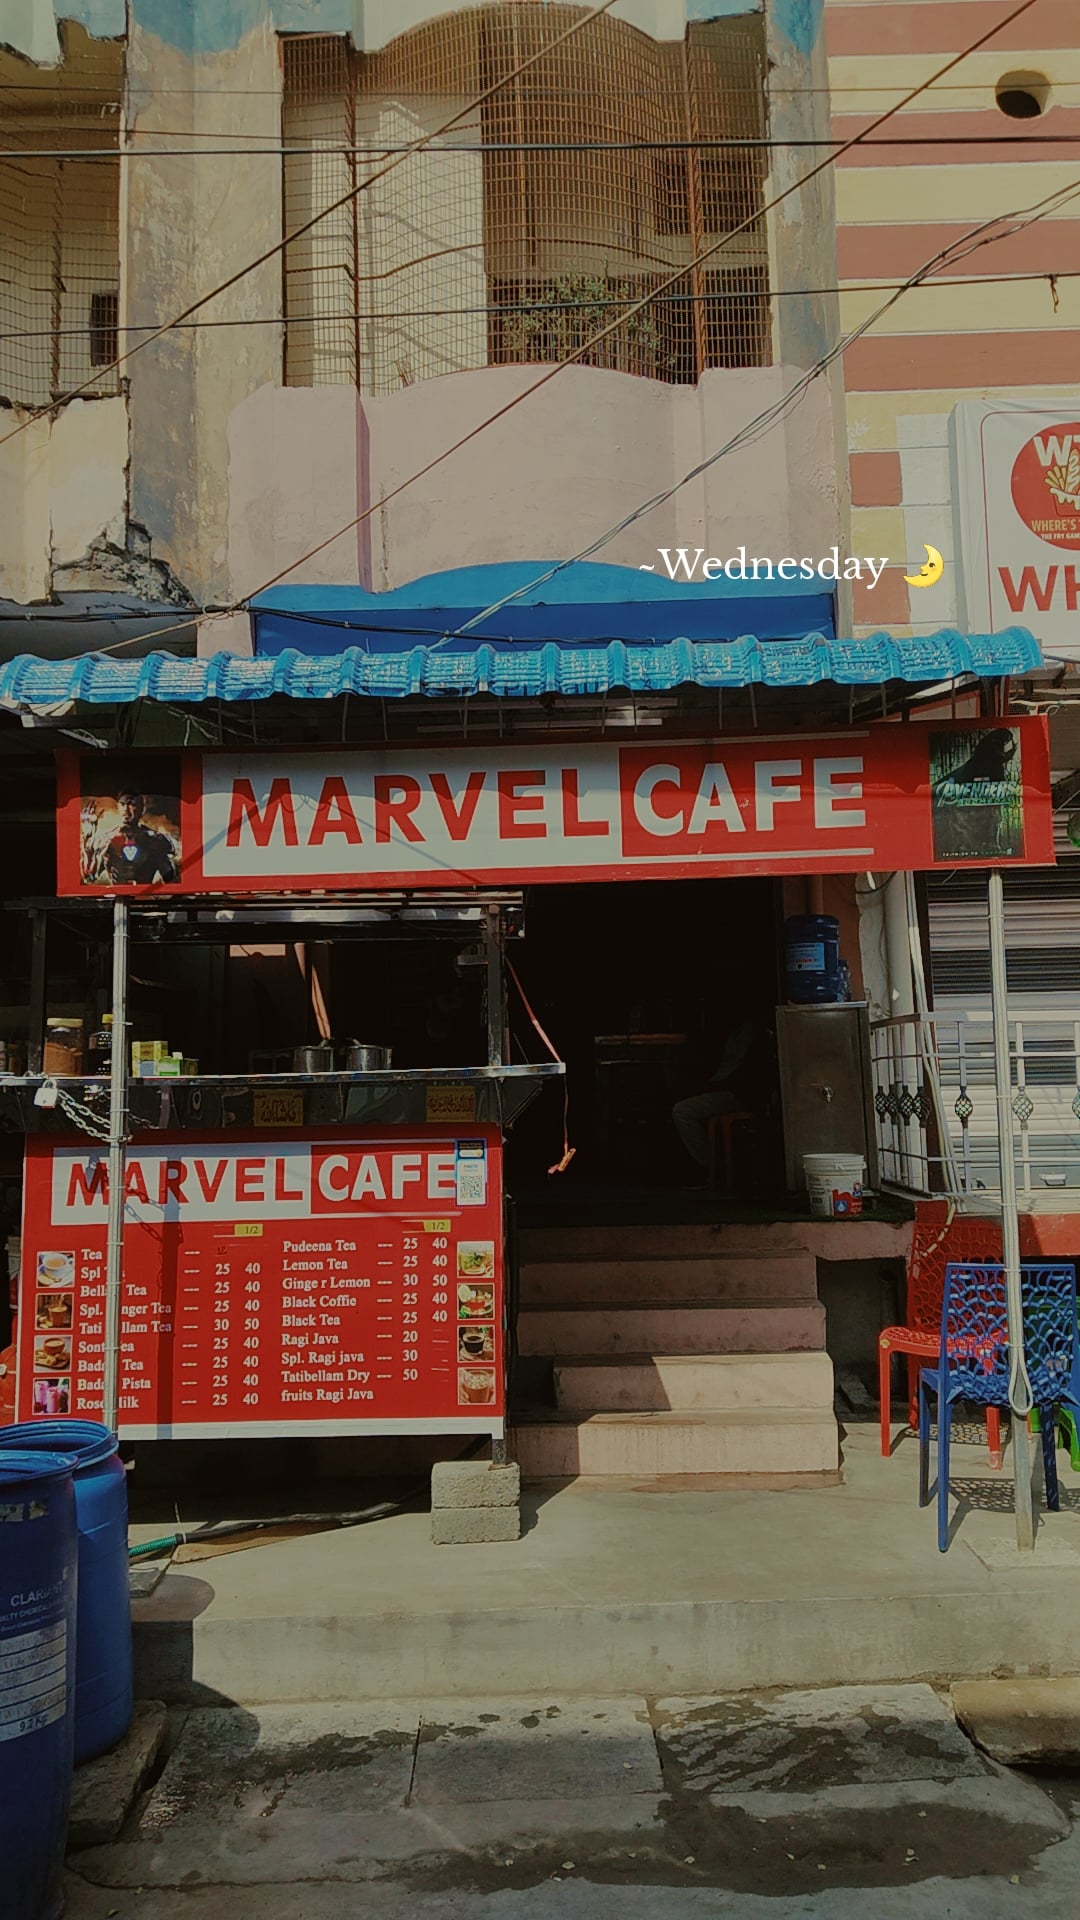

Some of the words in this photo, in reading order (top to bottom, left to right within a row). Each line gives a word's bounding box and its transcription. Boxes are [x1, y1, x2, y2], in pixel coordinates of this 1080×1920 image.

[1031, 519, 1077, 531] WHERE'S
[225, 767, 611, 848] MARVEL
[633, 756, 866, 837] CAFE
[66, 1158, 304, 1207] MARVEL
[318, 1153, 456, 1202] CAFE
[245, 1225, 259, 1235] 1/2
[432, 1221, 446, 1231] 1/2
[283, 1240, 333, 1253] Pudeena
[335, 1239, 357, 1251] Tea
[403, 1237, 418, 1250] 25
[432, 1237, 448, 1249] 40
[81, 1248, 103, 1260] Tea
[282, 1259, 324, 1271] Lemon
[327, 1258, 348, 1270] Tea
[403, 1255, 418, 1268] 25
[432, 1254, 448, 1267] 40
[80, 1266, 101, 1281] Spl
[215, 1263, 230, 1276] 25
[245, 1262, 261, 1275] 40
[126, 1283, 147, 1296] Tea
[214, 1281, 230, 1294] 25
[244, 1280, 260, 1293] 40
[330, 1276, 371, 1288] Lemon
[403, 1273, 419, 1286] 30
[432, 1274, 448, 1287] 50
[80, 1303, 103, 1318] Spl.
[150, 1302, 172, 1314] Tea
[214, 1299, 230, 1312] 25
[244, 1299, 260, 1311] 40
[282, 1295, 317, 1308] Black
[402, 1292, 418, 1305] 25
[432, 1292, 448, 1305] 40
[150, 1320, 172, 1333] Tea
[213, 1318, 230, 1331] 30
[244, 1317, 260, 1331] 50
[282, 1314, 317, 1327] Black
[319, 1313, 341, 1326] Tea
[402, 1311, 418, 1324] 25
[431, 1309, 448, 1323] 40
[78, 1341, 106, 1354] Sont
[120, 1341, 135, 1352] ea
[213, 1337, 229, 1350] 25
[243, 1336, 260, 1349] 40
[281, 1332, 310, 1348] Ragi
[312, 1332, 340, 1345] Java
[402, 1330, 418, 1343] 20
[77, 1359, 105, 1372] Bad
[122, 1358, 144, 1371] Tea
[213, 1356, 229, 1369] 25
[242, 1355, 259, 1368] 40
[281, 1351, 305, 1367] Spl.
[308, 1350, 336, 1366] Ragi
[338, 1350, 365, 1366] java
[402, 1349, 418, 1362] 30
[77, 1378, 105, 1391] Bad
[122, 1377, 152, 1390] Pista
[213, 1375, 229, 1388] 25
[242, 1374, 259, 1387] 40
[281, 1370, 344, 1383] Tatibellam
[347, 1368, 371, 1384] Dry
[402, 1368, 418, 1381] 50
[212, 1393, 228, 1406] 25
[242, 1392, 259, 1405] 40
[281, 1388, 313, 1402] fruits
[316, 1387, 345, 1404] Ragi
[347, 1387, 374, 1400] Java
